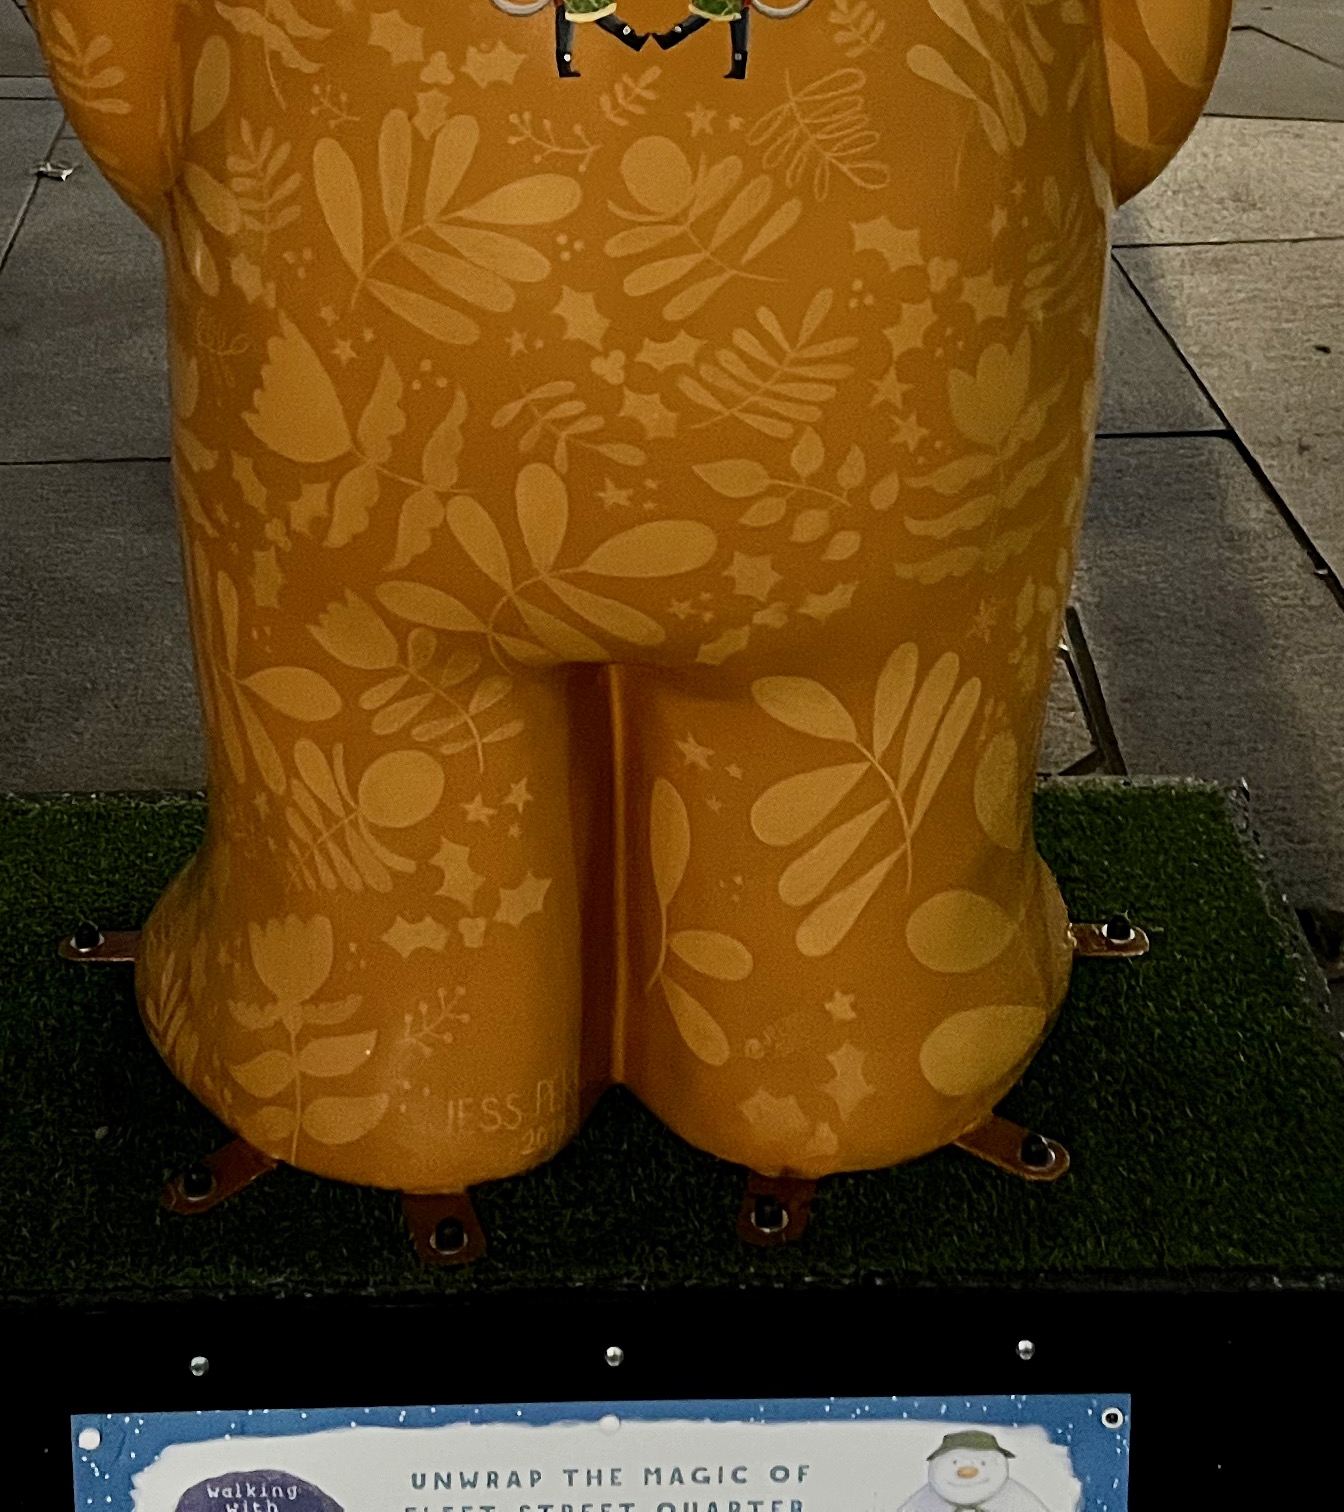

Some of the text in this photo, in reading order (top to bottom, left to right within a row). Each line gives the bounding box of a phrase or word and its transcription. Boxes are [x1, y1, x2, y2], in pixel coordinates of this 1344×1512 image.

[411, 1465, 810, 1490] UNWRAP THE MAGIC OF
[206, 1483, 298, 1500] walking
